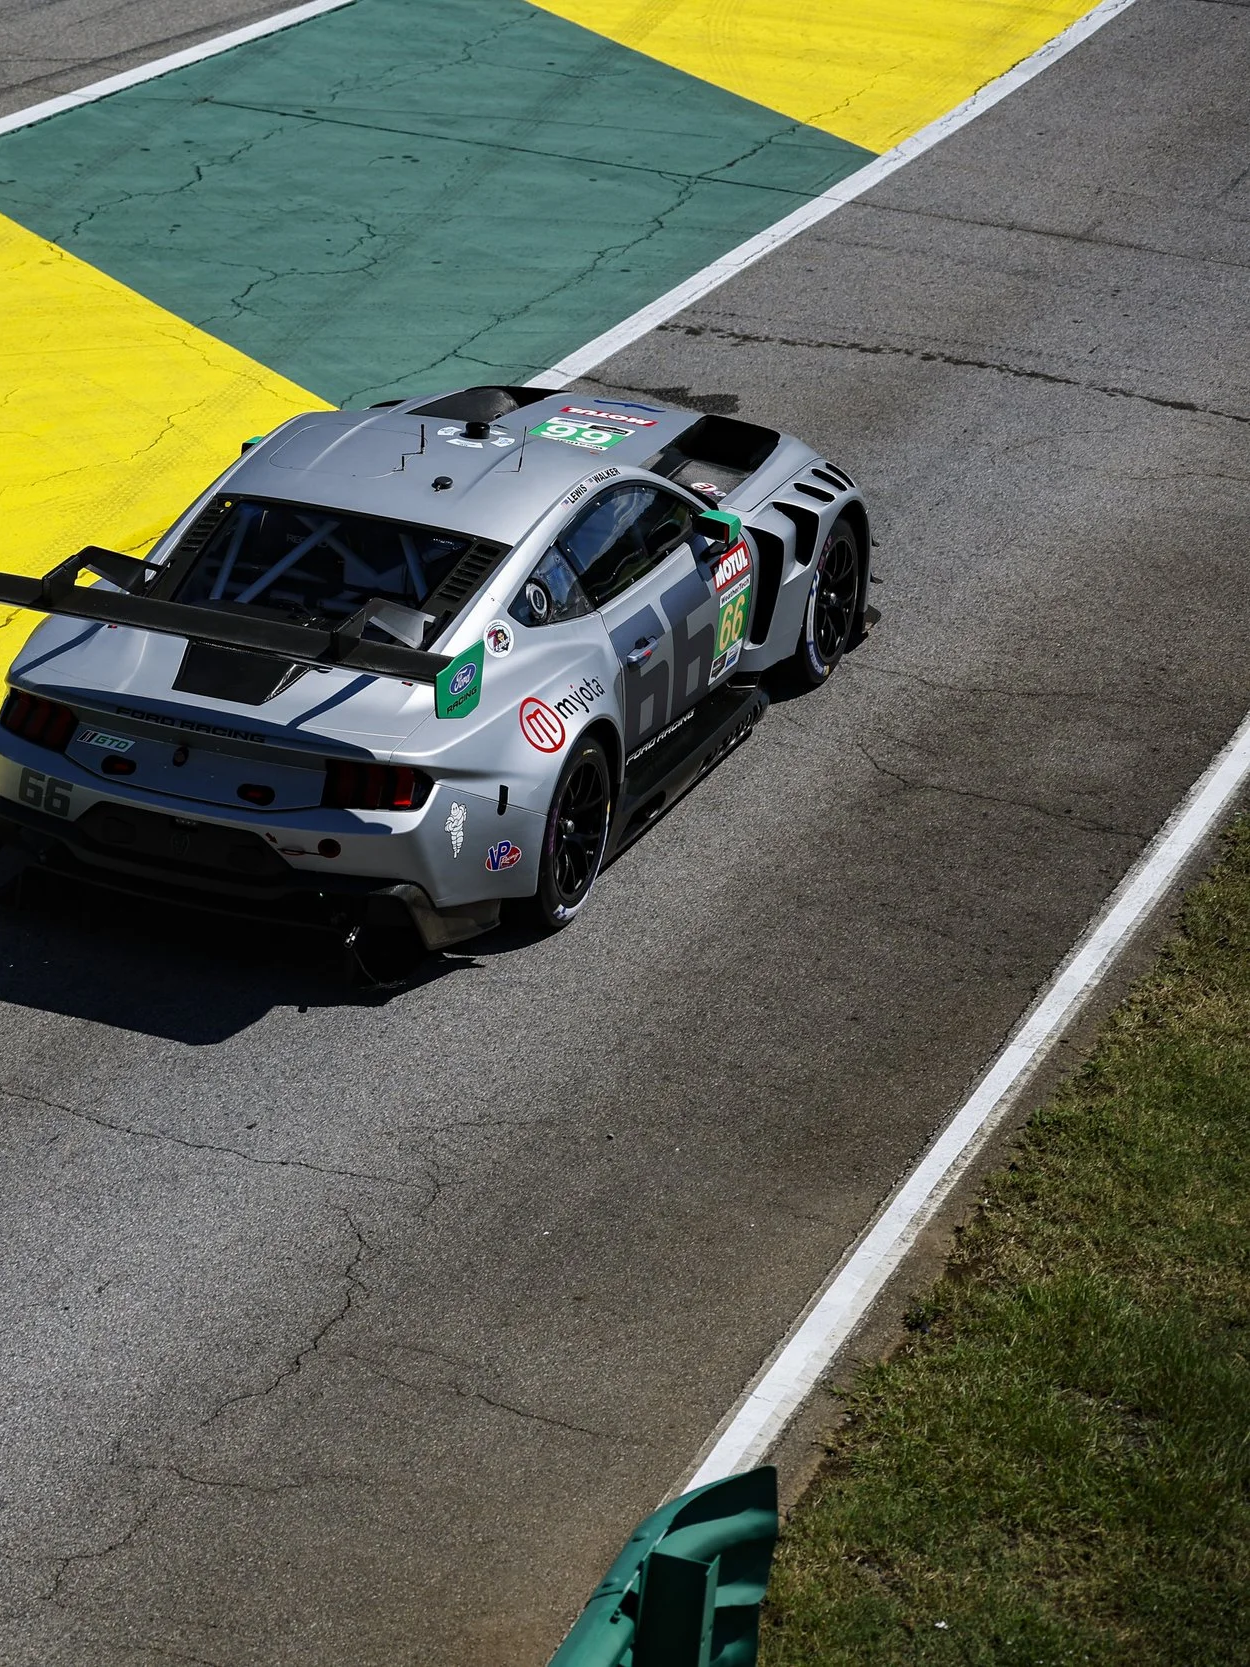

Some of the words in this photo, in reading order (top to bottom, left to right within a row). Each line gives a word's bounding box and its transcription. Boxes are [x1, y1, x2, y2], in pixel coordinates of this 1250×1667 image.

[567, 407, 654, 425] MOTUL
[567, 484, 588, 504] LEWIS
[593, 467, 621, 484] WALKER
[715, 547, 748, 589] MOTUL
[720, 594, 745, 651] 66
[453, 667, 473, 692] Ford
[446, 685, 477, 715] RACING
[554, 677, 606, 720] myota
[94, 733, 130, 750] GTD
[115, 706, 176, 727] FORD
[179, 719, 266, 744] RACING
[626, 736, 656, 766] FORD
[657, 707, 696, 743] RACING
[18, 766, 73, 817] 66
[488, 841, 511, 870] VP
